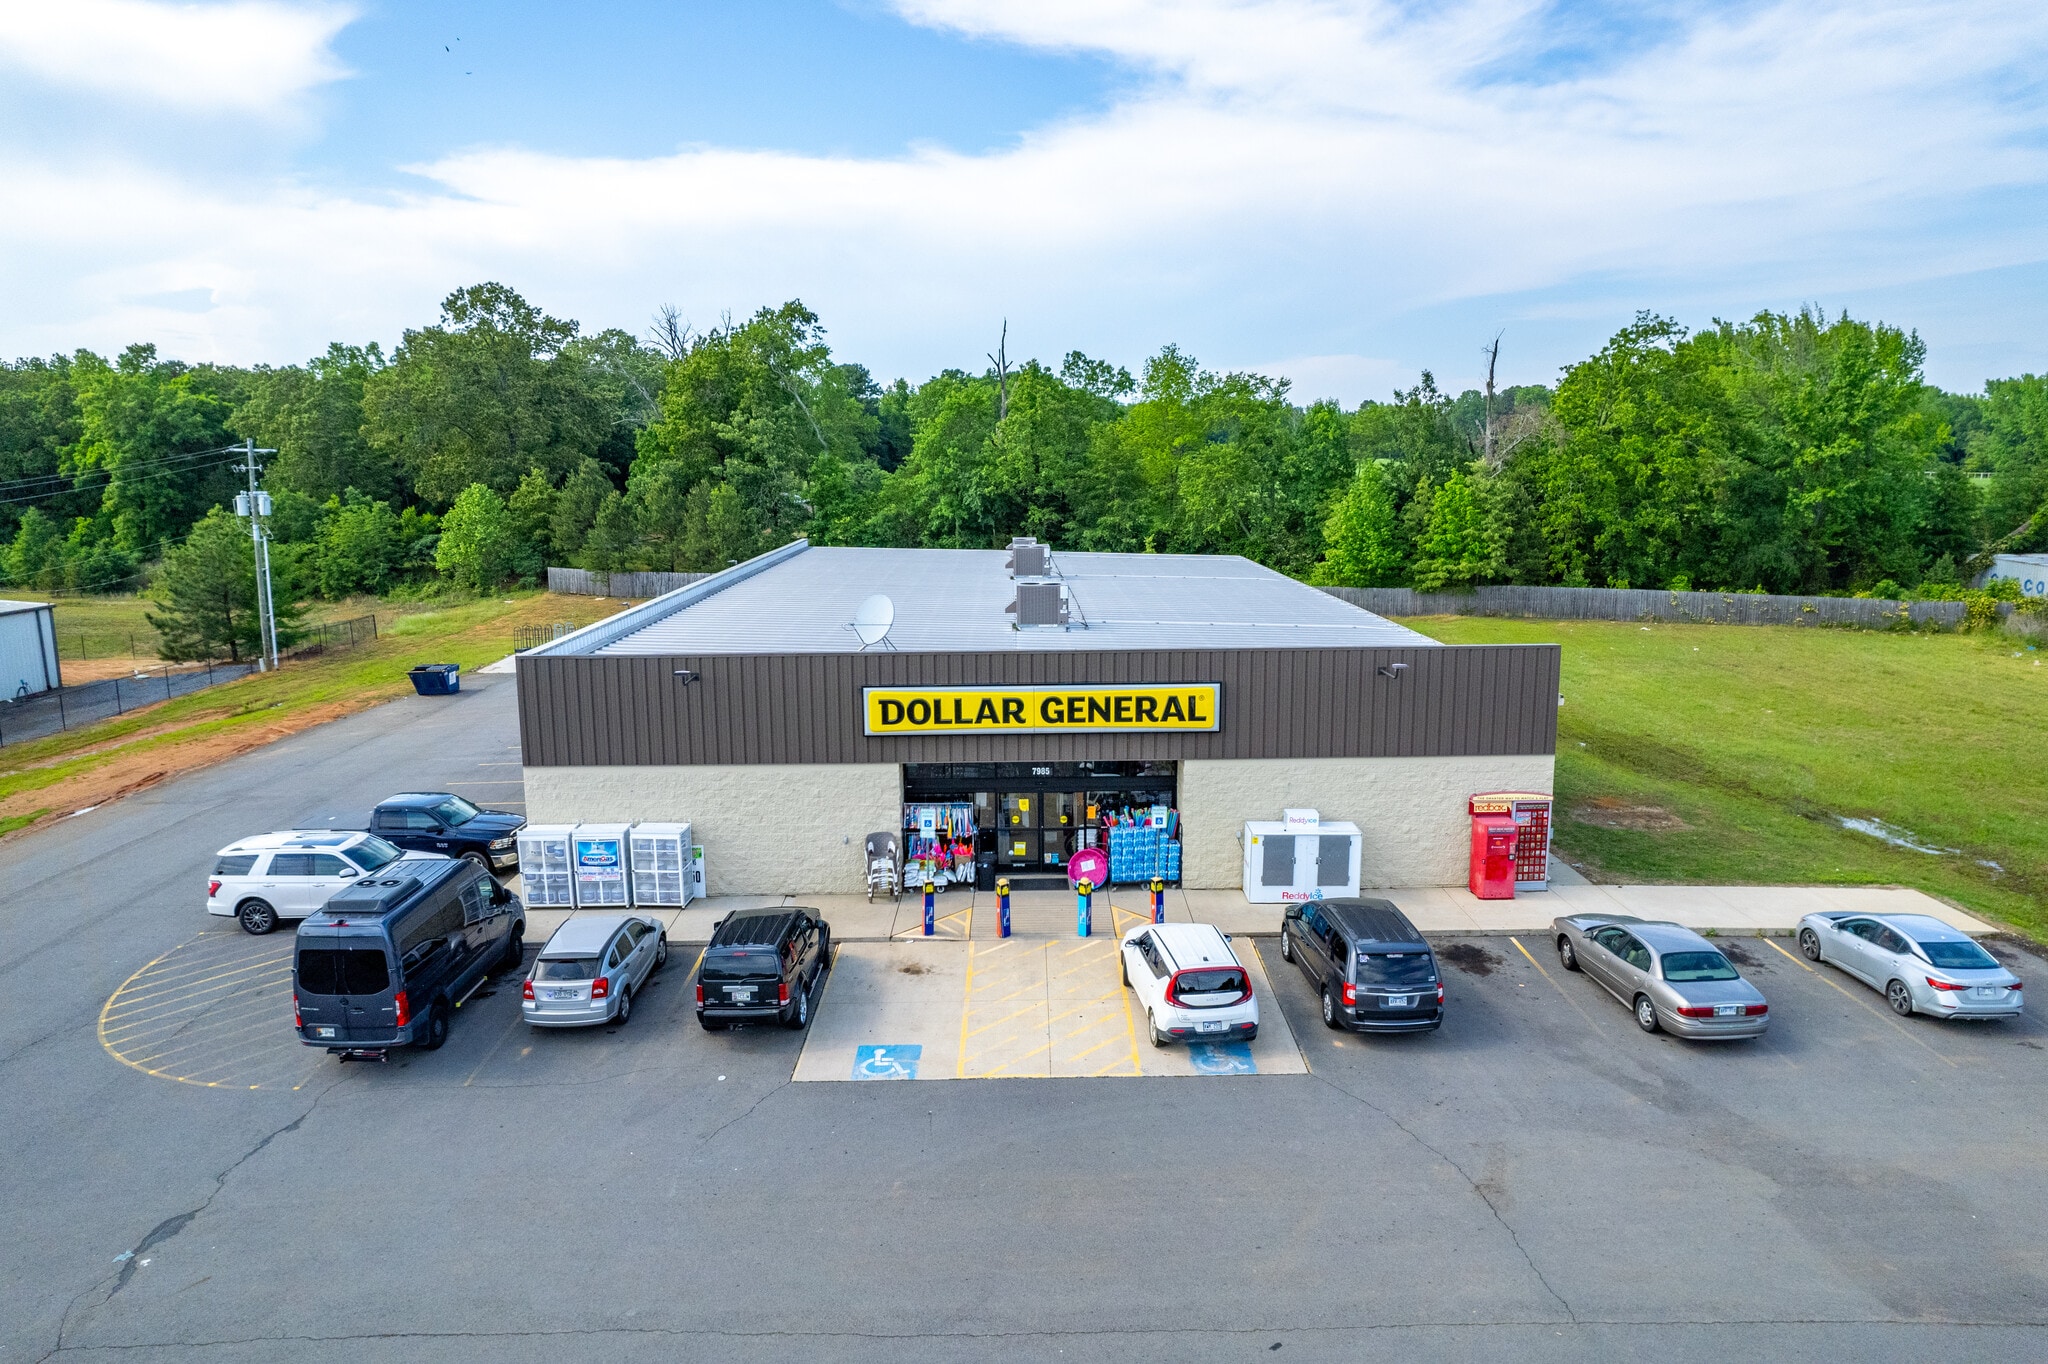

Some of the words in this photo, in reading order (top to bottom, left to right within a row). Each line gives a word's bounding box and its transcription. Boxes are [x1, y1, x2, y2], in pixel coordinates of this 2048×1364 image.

[878, 697, 1027, 726] DOLLAR
[1039, 695, 1207, 724] GENERAL
[1031, 767, 1050, 776] 7985
[1475, 802, 1504, 812] redbox
